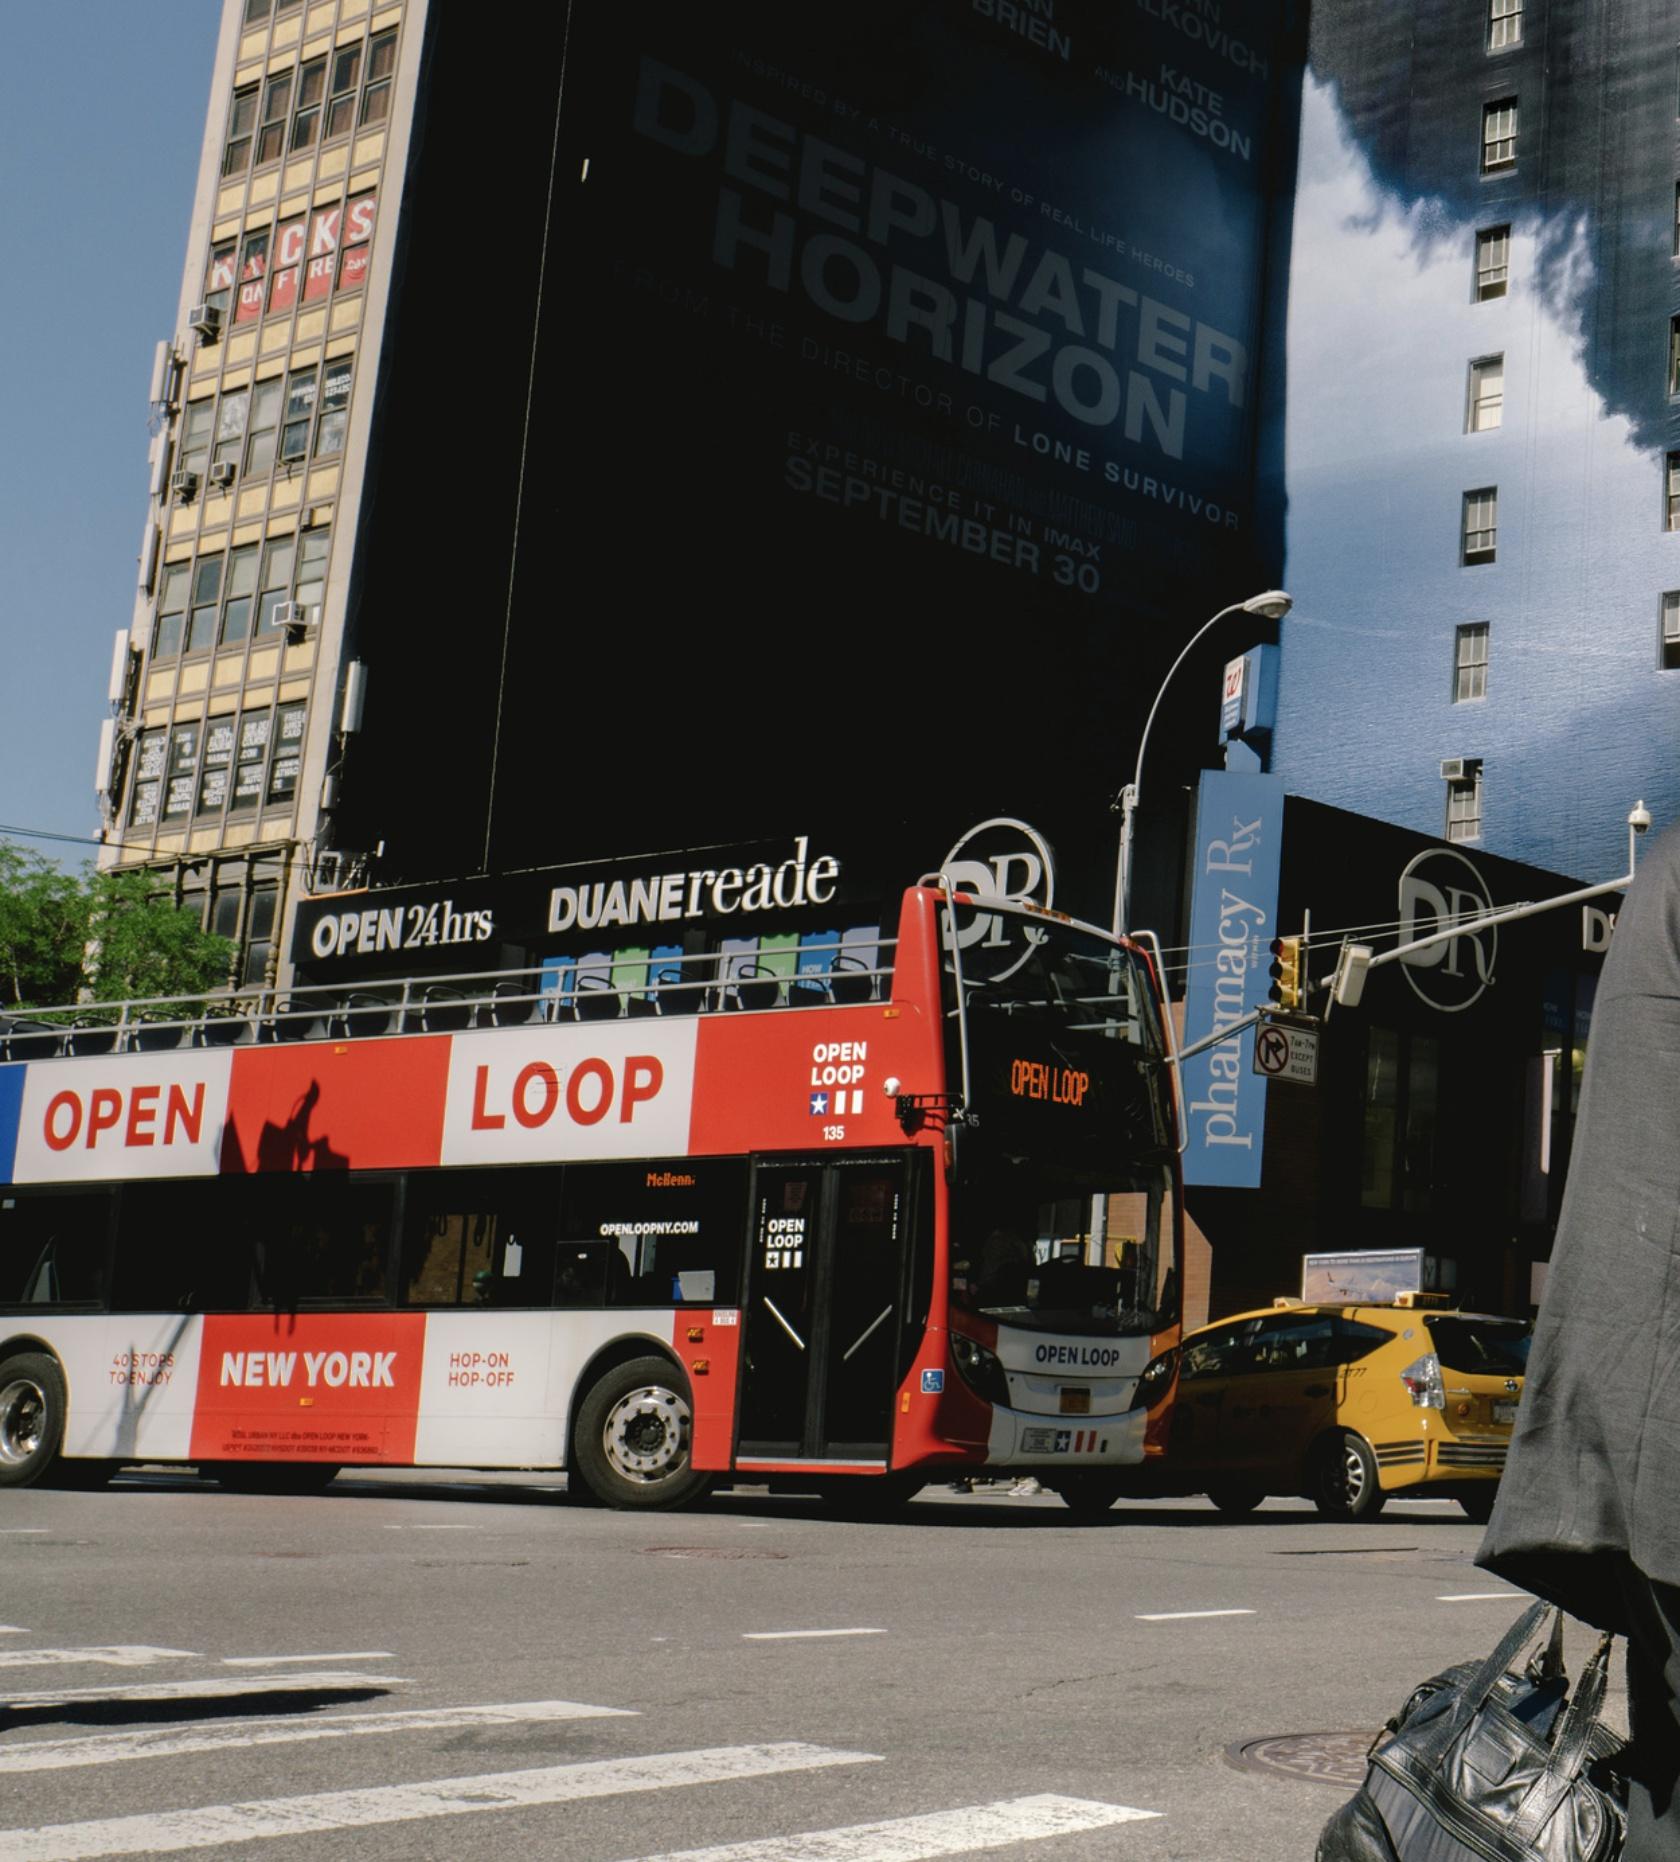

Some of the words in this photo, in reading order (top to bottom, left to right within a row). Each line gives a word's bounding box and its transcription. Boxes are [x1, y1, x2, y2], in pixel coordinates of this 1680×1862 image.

[1095, 65, 1126, 91] AND
[1126, 71, 1251, 160] HUDSON
[1160, 63, 1223, 116] KATE
[729, 48, 826, 105] INSPIRED
[833, 100, 861, 120] BY
[868, 117, 880, 131] A
[888, 126, 937, 160] TRUE
[943, 154, 1005, 193] STORY
[1010, 187, 1034, 207] OF
[1040, 202, 1085, 234] REAL
[1090, 226, 1126, 254] LIFE
[1131, 246, 1195, 288] HEROES
[633, 53, 1248, 409] DEEPWATER
[712, 184, 1188, 462] HORIZON
[726, 305, 785, 351] THE
[800, 336, 953, 416] DIRECTOR
[966, 405, 1001, 432] OF
[1014, 423, 1091, 472] LONE
[1103, 461, 1239, 531] SURVIVOR
[785, 431, 961, 510] EXPERIENCE
[973, 500, 996, 522] IT
[1008, 514, 1033, 536] IN
[1043, 526, 1101, 562] IMAX
[784, 454, 1041, 575] SEPTEMBER
[1052, 553, 1101, 594] 30
[1206, 816, 1263, 876] Rx
[548, 873, 684, 933] DUANE
[685, 836, 840, 918] reade
[312, 907, 405, 958] OPEN
[403, 900, 493, 949] 24hrs
[1399, 875, 1497, 985] DR
[1191, 888, 1265, 1150] pharmacy
[811, 1065, 865, 1086] LOOP
[813, 1041, 867, 1063] OPEN
[43, 1082, 206, 1151] OPEN
[470, 1055, 665, 1132] LOOP
[1011, 1058, 1048, 1099] OPEN
[1052, 1067, 1089, 1106] LOOP
[823, 1125, 845, 1141] 135
[600, 1221, 699, 1236] OPENLOOPNY.COM
[767, 1234, 804, 1249] LOOP
[768, 1218, 805, 1233] OPEN
[109, 1371, 128, 1385] TO
[129, 1371, 173, 1385] ENJOY
[113, 1353, 130, 1368] 40
[131, 1353, 175, 1368] STOPS
[220, 1351, 297, 1387] NEW
[303, 1351, 398, 1387] YORK
[448, 1371, 515, 1387] HOP-OFF
[449, 1353, 510, 1369] HOP-ON
[1035, 1344, 1079, 1364] OPEN
[1082, 1347, 1120, 1367] LOOP
